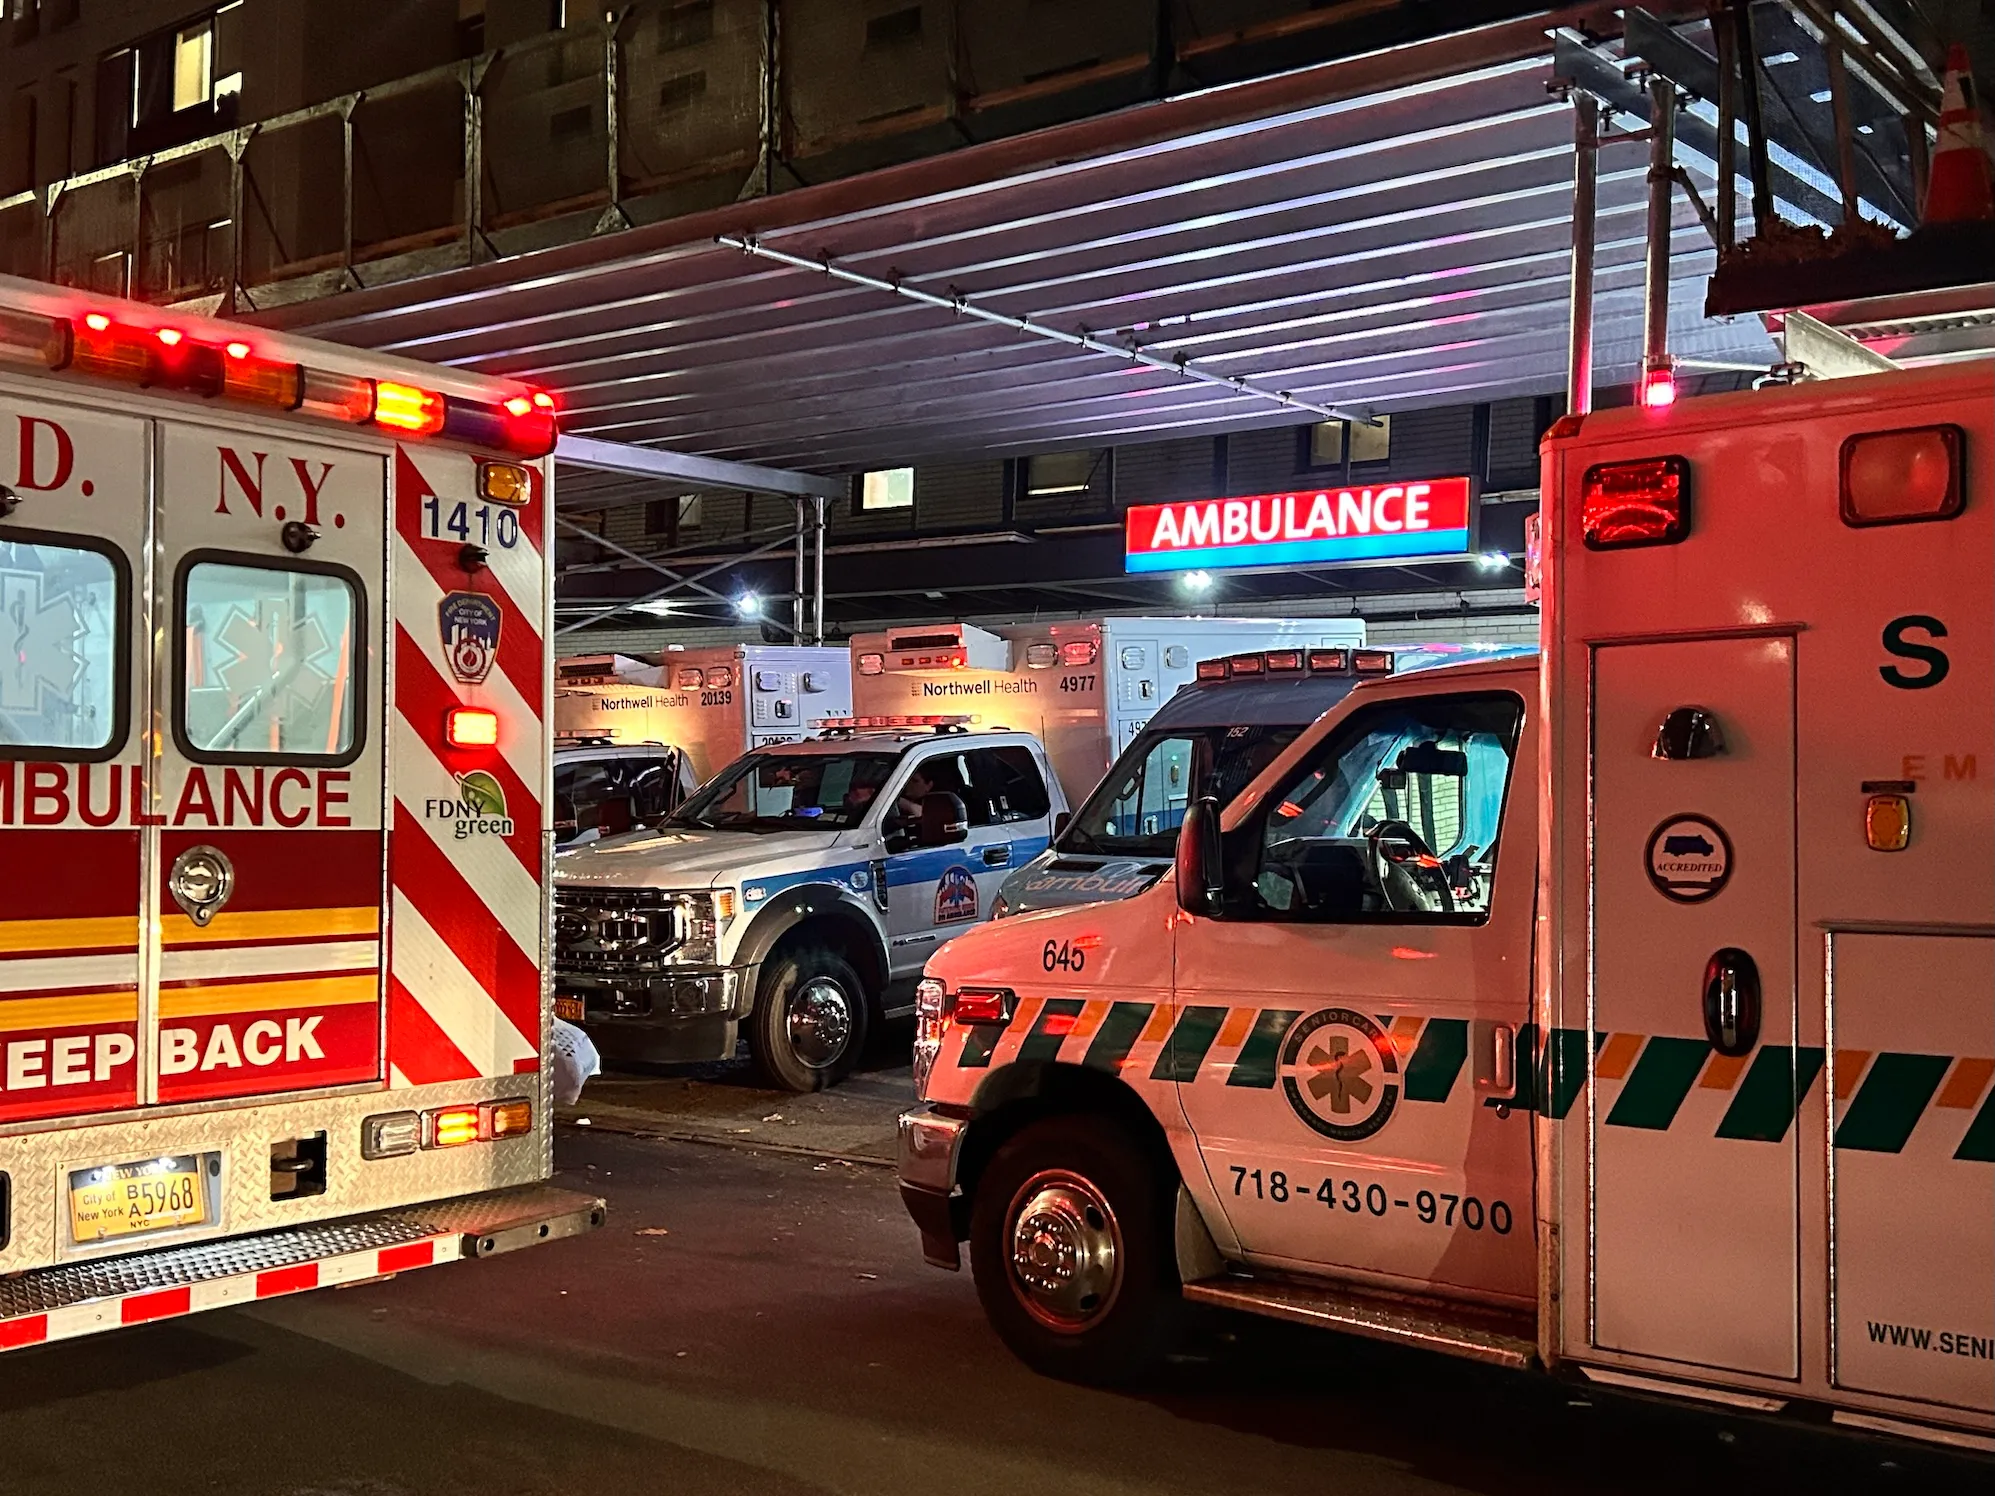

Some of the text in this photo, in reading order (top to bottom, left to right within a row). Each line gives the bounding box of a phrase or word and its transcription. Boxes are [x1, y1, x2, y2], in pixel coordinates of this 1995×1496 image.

[214, 446, 345, 529] N.Y.
[424, 497, 518, 549] 1410
[1151, 485, 1431, 549] AMBULANCE
[454, 616, 487, 627] NEW YORK
[458, 607, 482, 617] CITY OF
[1878, 614, 1950, 690] S
[924, 678, 1037, 696] Northwell Health
[1060, 675, 1096, 693] 4977
[601, 694, 689, 711] Northwell Health
[701, 690, 732, 706] 20139
[1226, 726, 1250, 738] 152
[426, 799, 486, 819] FDNY
[454, 819, 513, 840] green
[1656, 862, 1723, 873] ACCREDITED
[1042, 939, 1085, 973] 645
[1294, 1011, 1386, 1046] SENIORCAR
[159, 1015, 326, 1076] BACK
[0, 1033, 135, 1092] EEP
[83, 1191, 117, 1206] City of
[1229, 1165, 1513, 1235] 718-430-9700
[77, 1206, 124, 1222] New York
[130, 1219, 150, 1229] NYC
[1867, 1321, 1994, 1361] WWW.SENI
